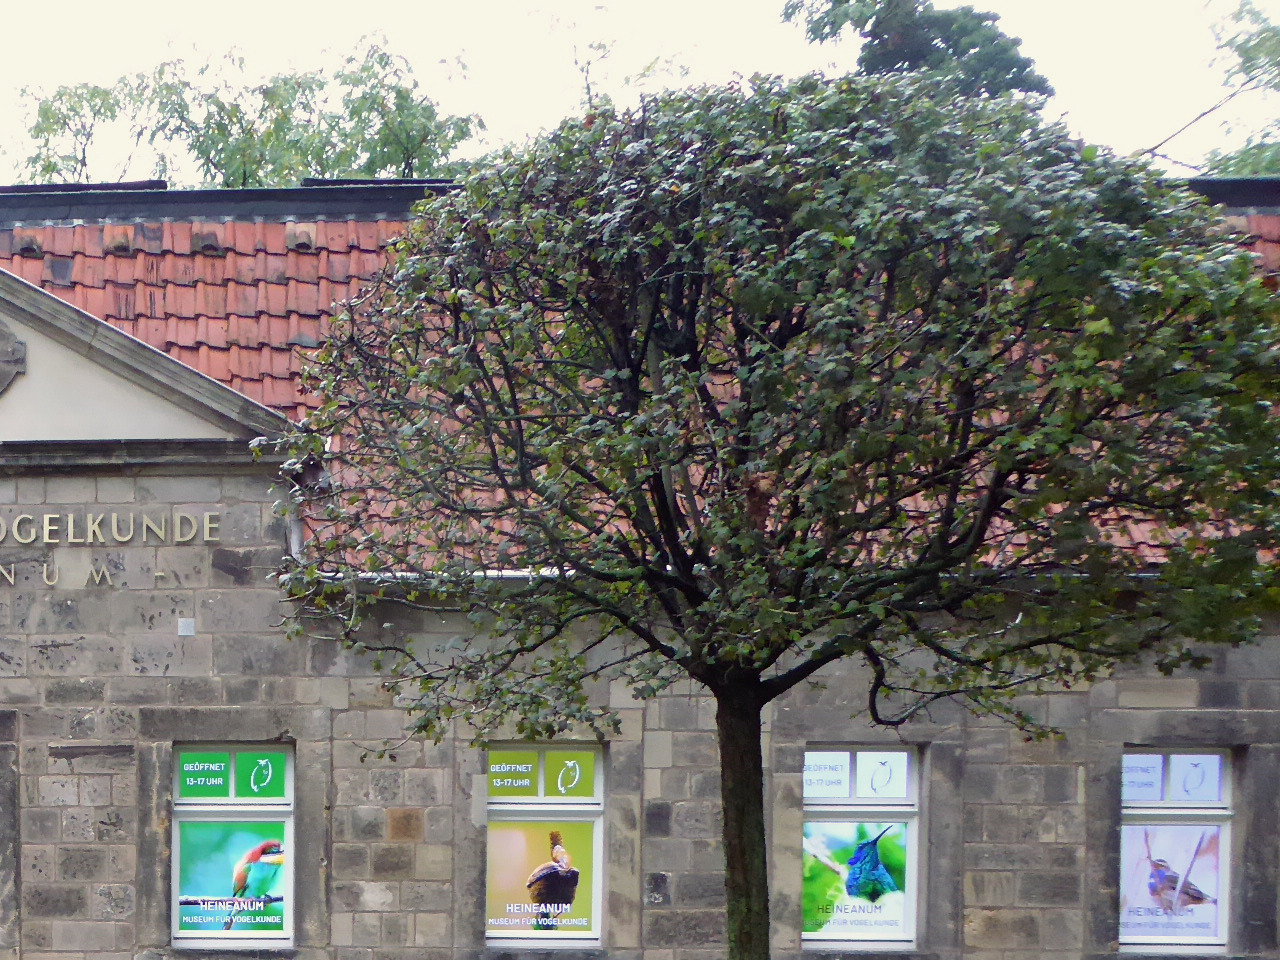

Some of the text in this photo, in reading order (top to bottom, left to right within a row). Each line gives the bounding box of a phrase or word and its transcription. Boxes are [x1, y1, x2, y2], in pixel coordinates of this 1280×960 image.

[184, 762, 225, 770] GEÖFFNET
[491, 763, 532, 772] GEÖFFNET
[200, 901, 264, 911] HEINEANUM
[506, 904, 570, 913] HEINEANUM
[817, 905, 882, 914] HEINEANUM
[215, 915, 230, 923] FÜR
[522, 917, 536, 925] FÜR
[833, 918, 847, 926] FÜR
